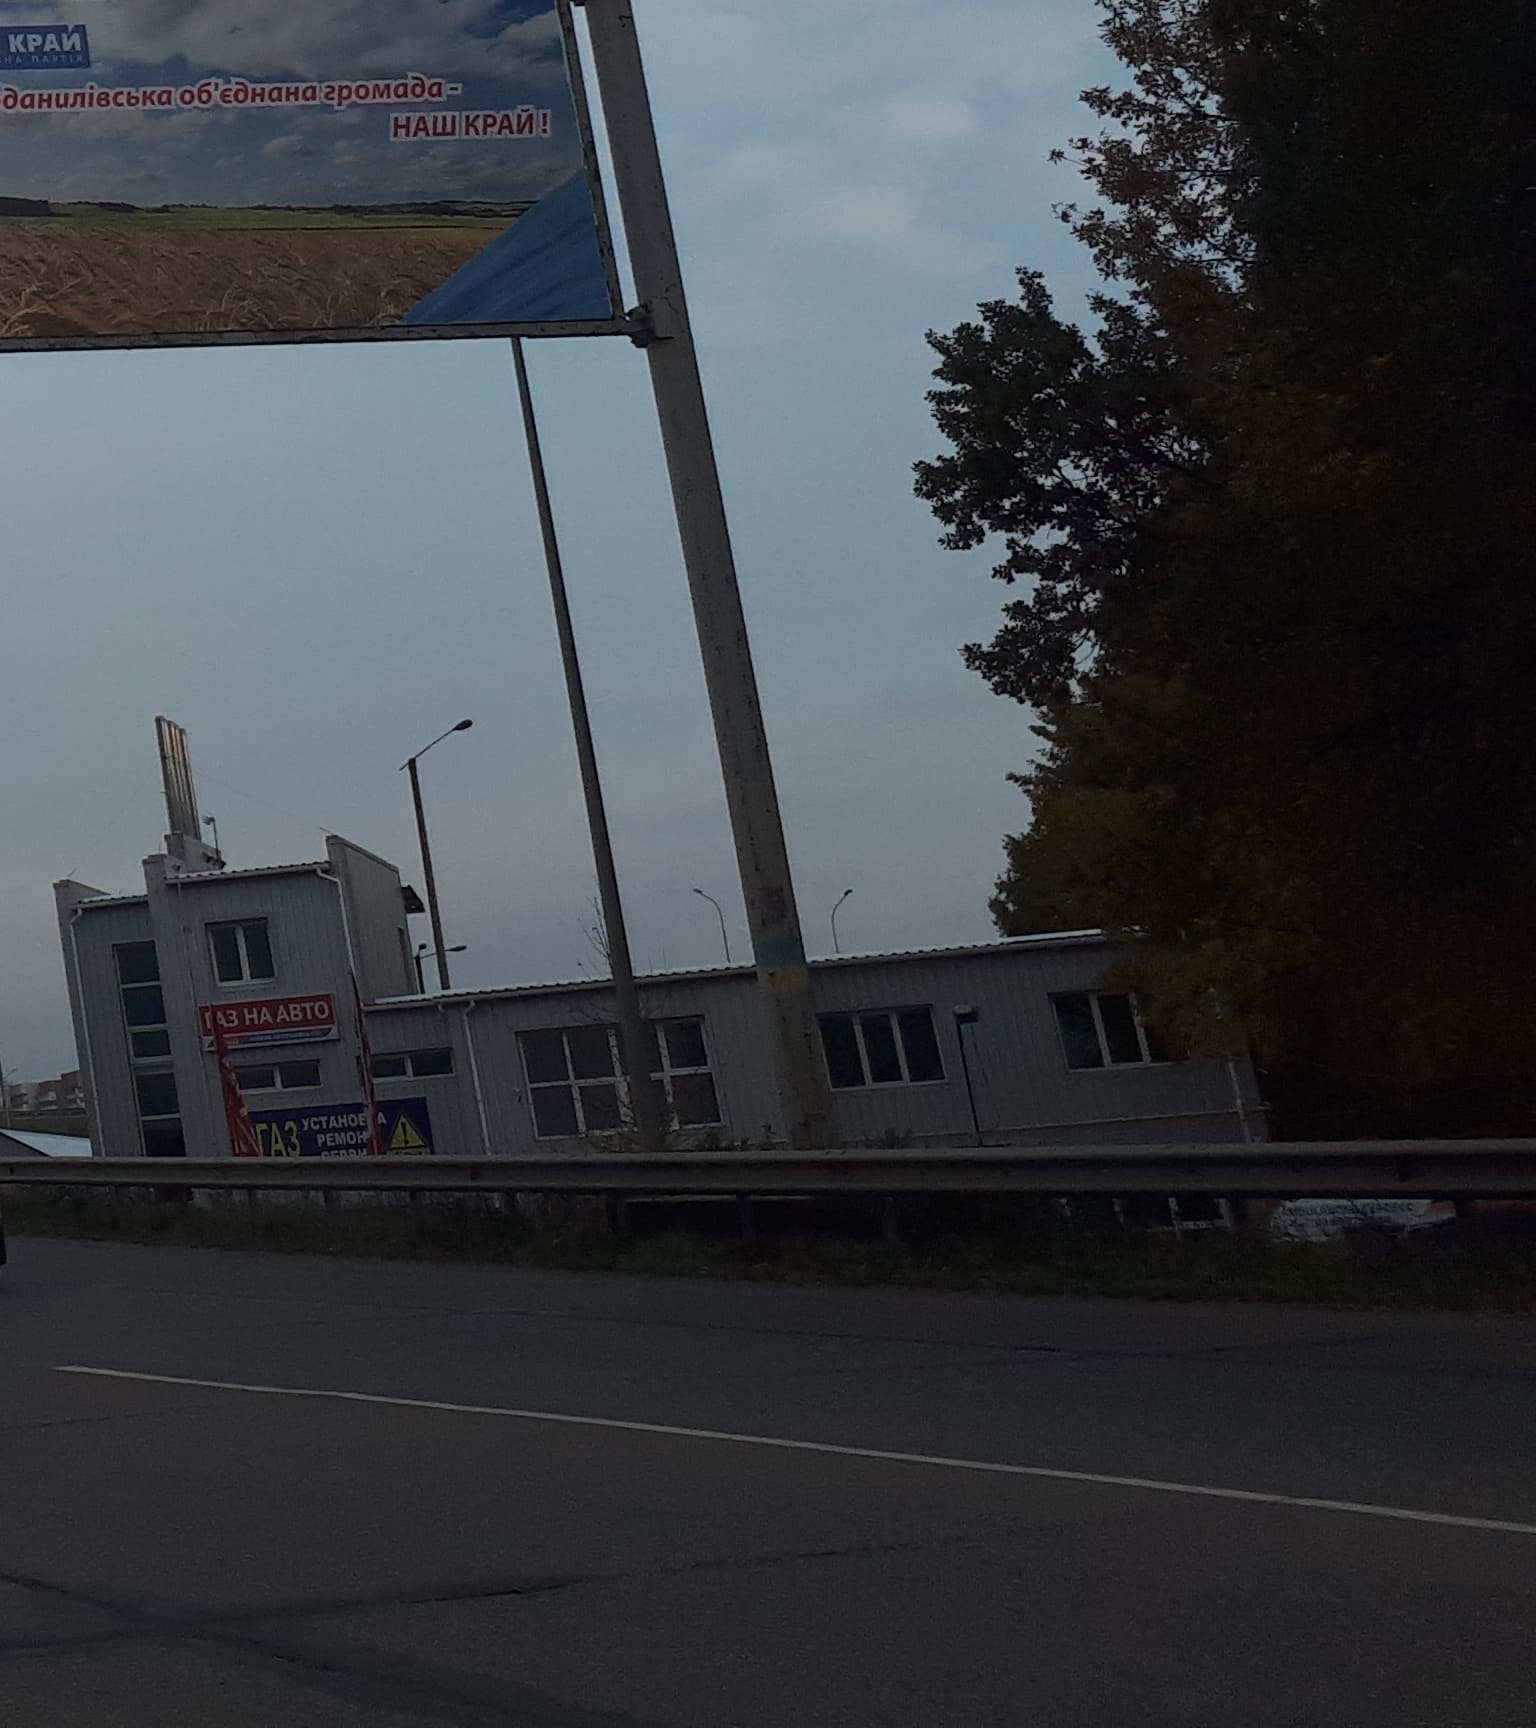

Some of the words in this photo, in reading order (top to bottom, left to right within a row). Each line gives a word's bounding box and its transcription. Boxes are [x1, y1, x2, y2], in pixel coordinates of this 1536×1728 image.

[8, 29, 81, 53] КРАЙ
[32, 55, 83, 64] ПАРТІЯ
[179, 80, 317, 106] об'єднана
[393, 115, 456, 137] НАШ
[245, 1008, 273, 1025] НА
[277, 1001, 329, 1022] АВТО
[317, 1131, 369, 1147] РЕМОН
